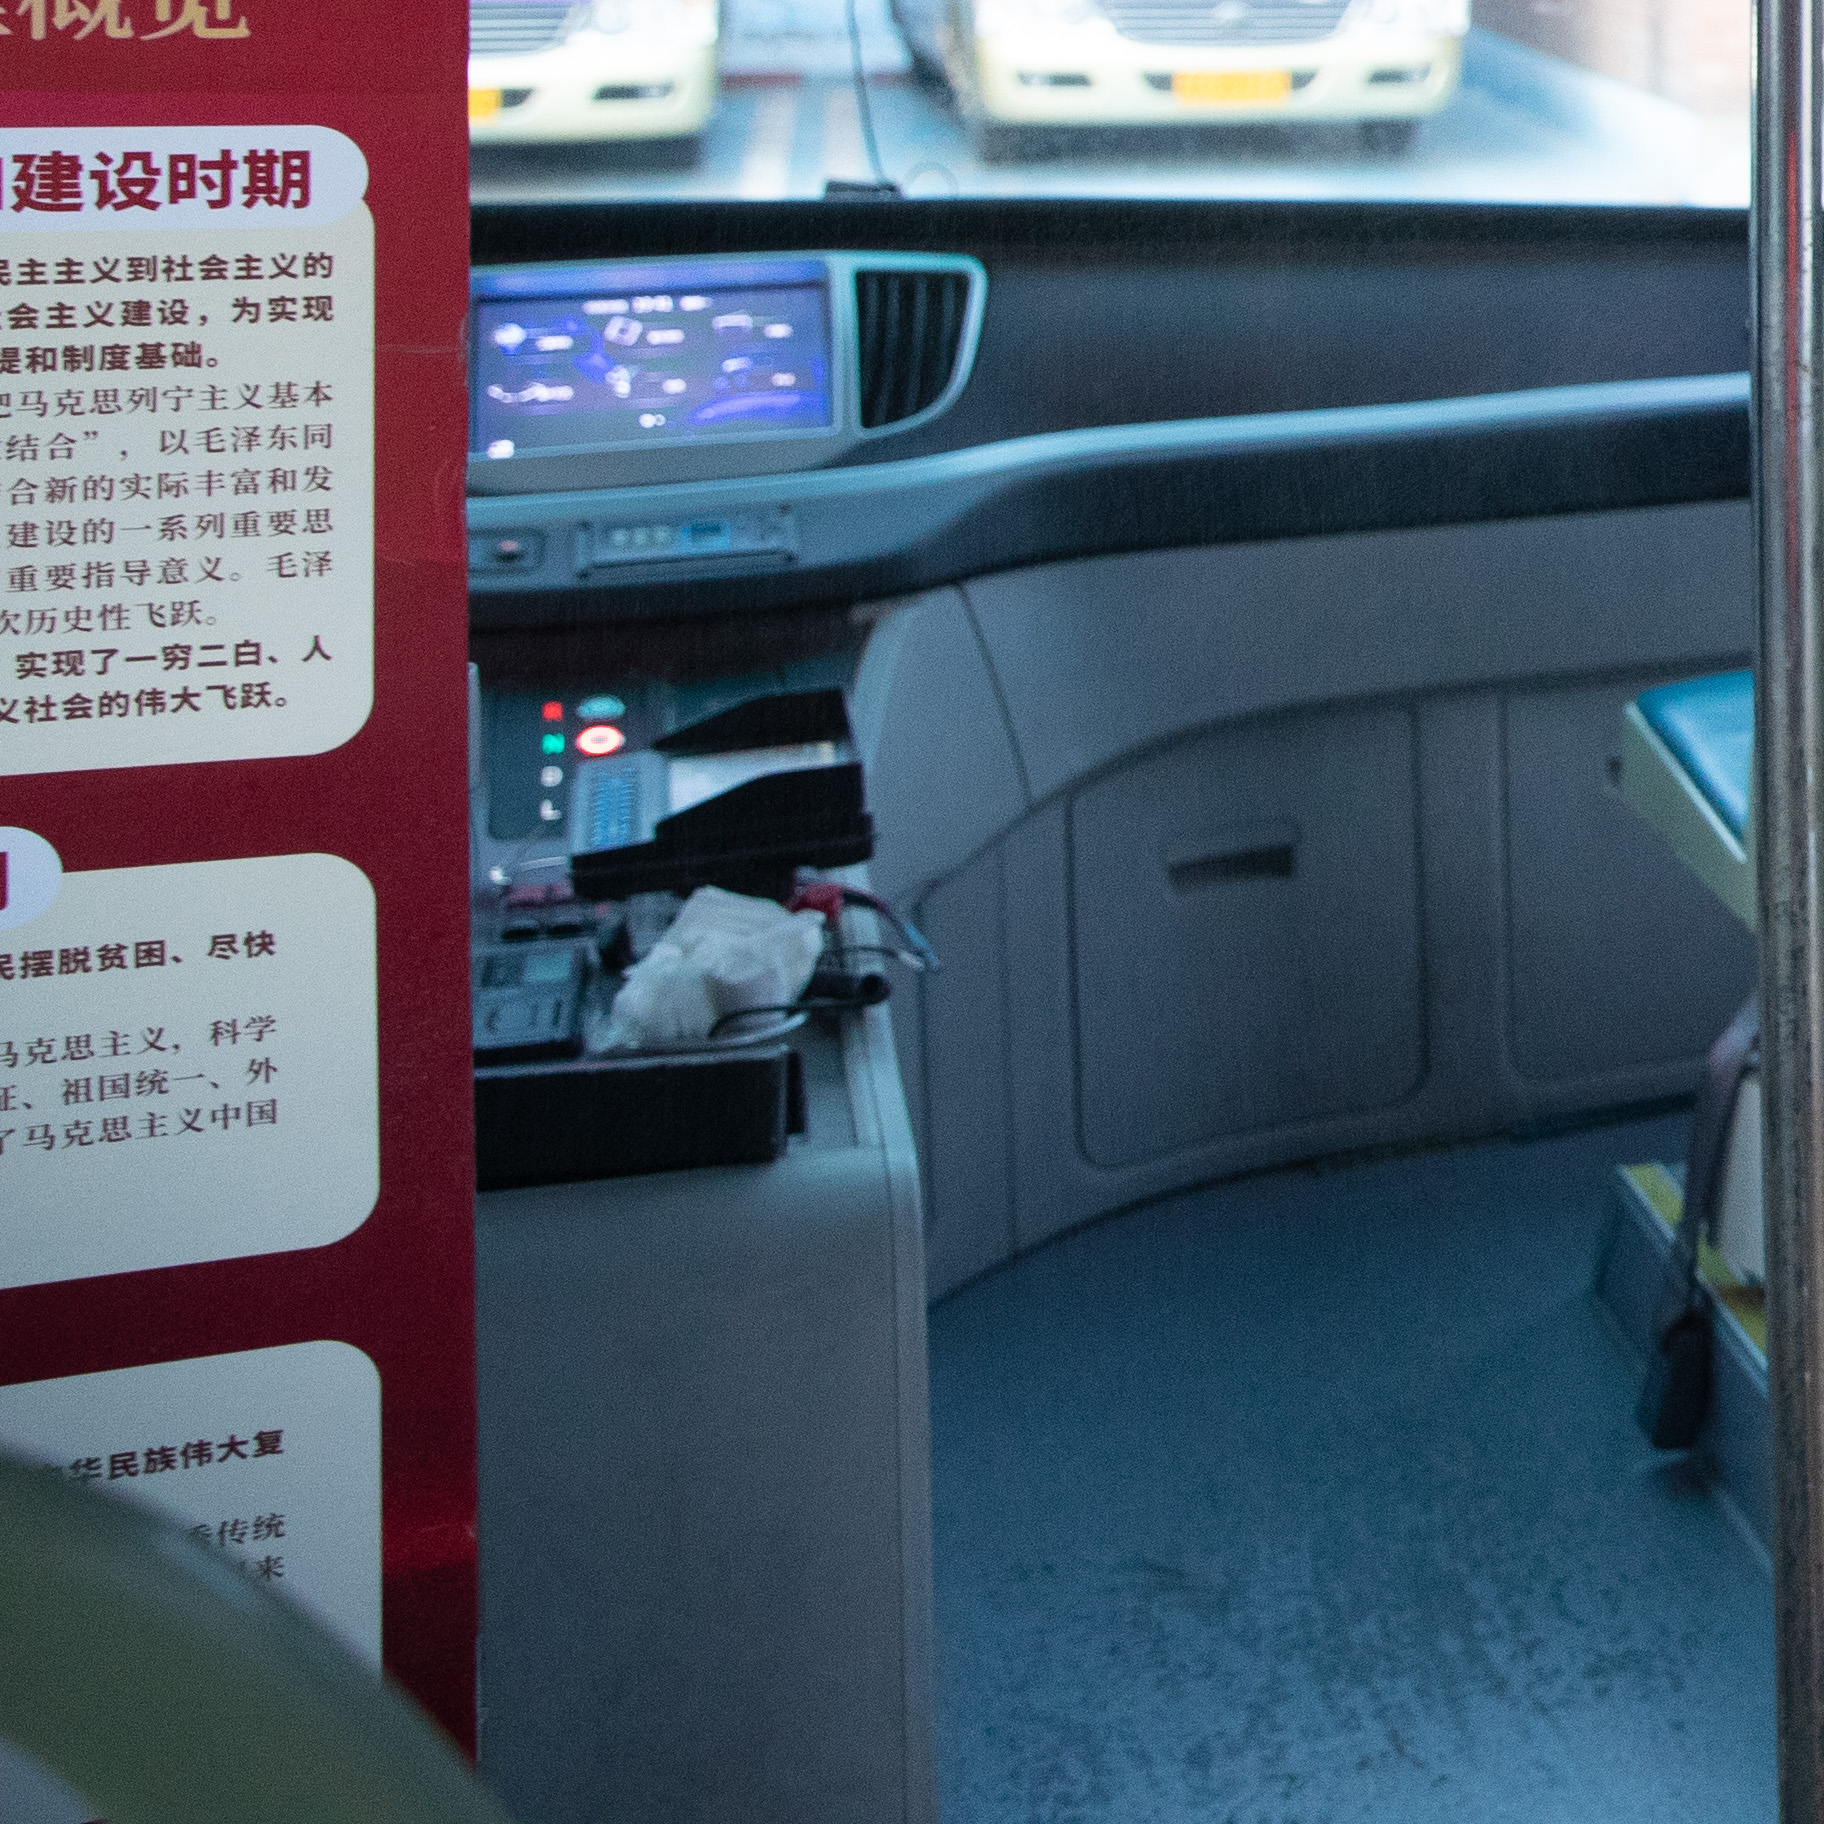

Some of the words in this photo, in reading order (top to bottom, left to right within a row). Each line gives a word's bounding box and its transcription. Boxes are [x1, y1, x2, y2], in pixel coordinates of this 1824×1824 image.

[0, 149, 311, 213] 建设时期
[0, 295, 335, 330] 会主义建设，为实现
[0, 423, 333, 462] 结合”，以毛泽东同
[6, 508, 334, 549] 建设的一系列重要思
[58, 1428, 285, 1481] 华民族伟大复
